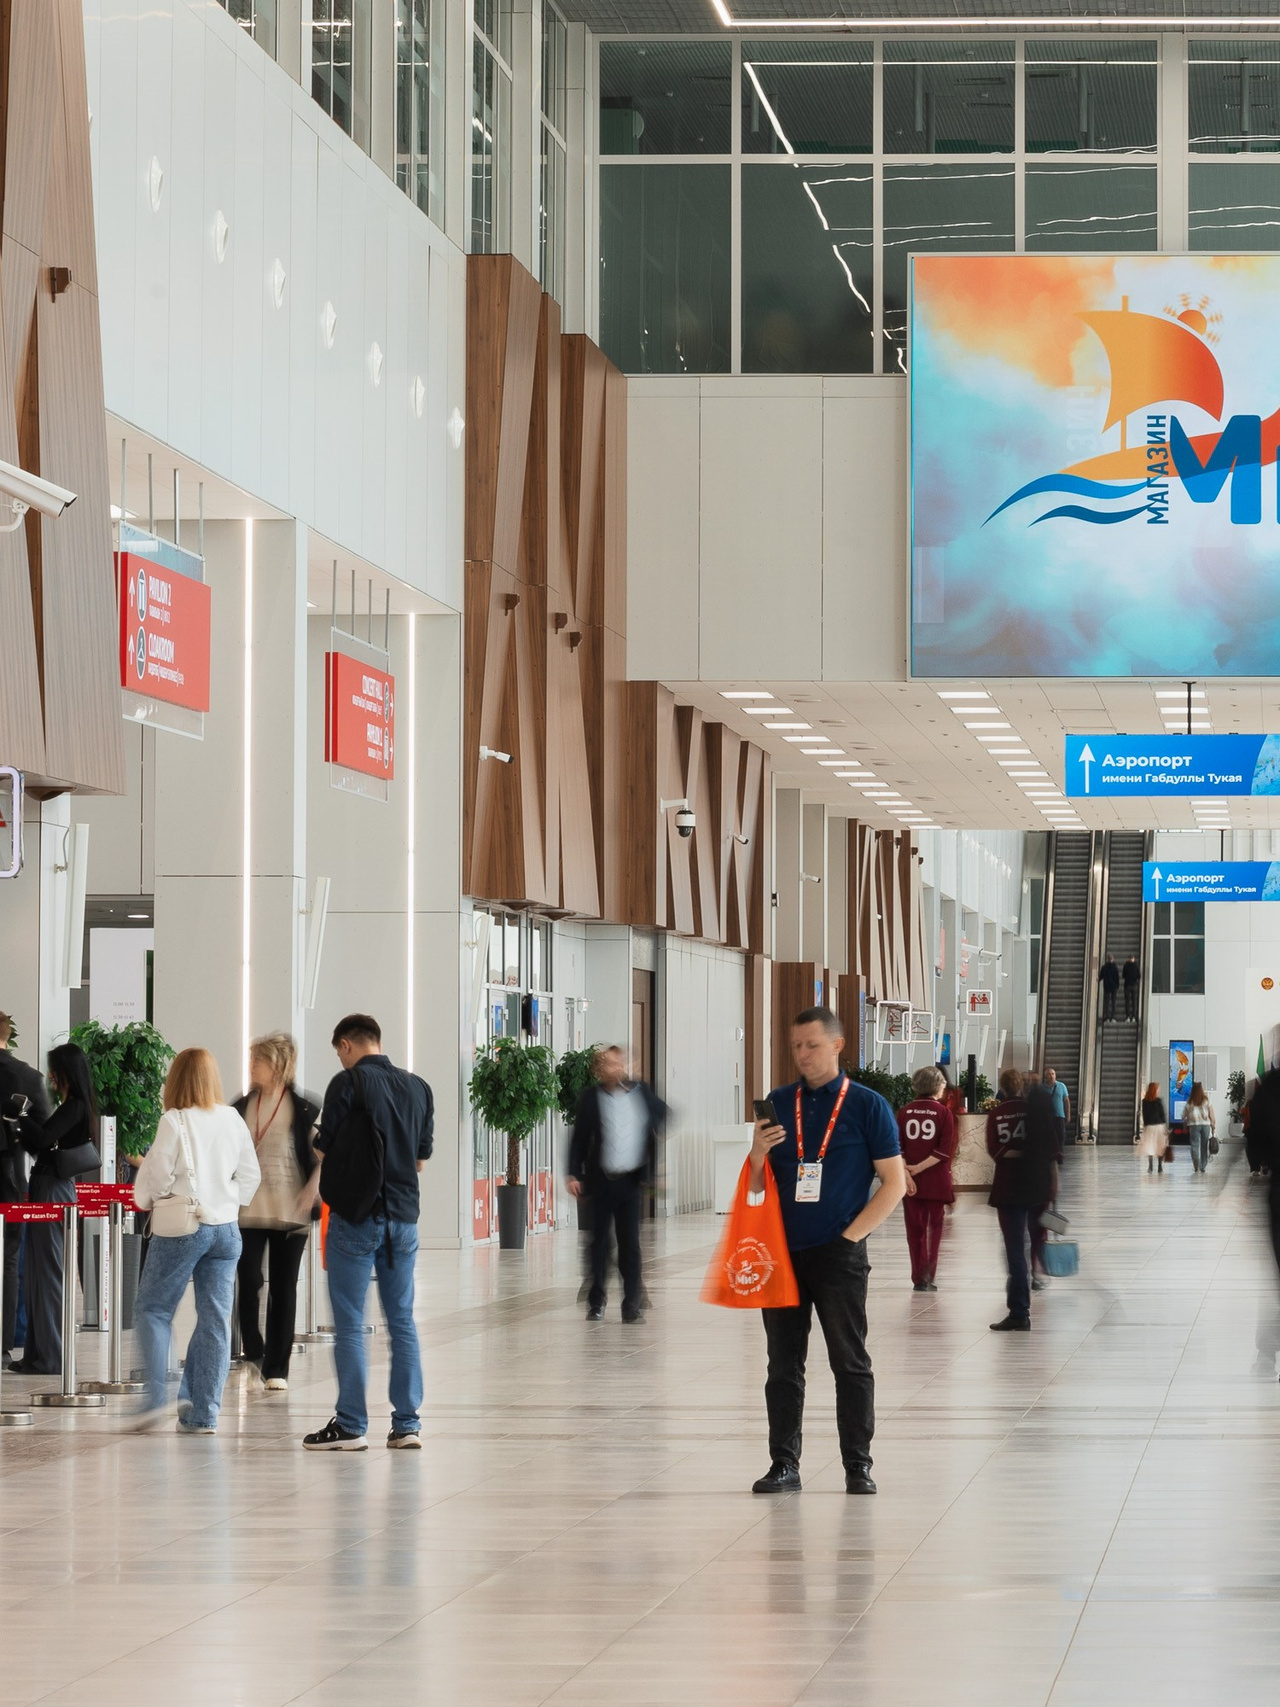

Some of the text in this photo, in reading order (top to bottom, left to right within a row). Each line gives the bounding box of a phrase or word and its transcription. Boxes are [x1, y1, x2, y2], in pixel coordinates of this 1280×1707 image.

[1147, 415, 1169, 524] МАГАЗИН
[1102, 754, 1192, 770] Аэропорт
[1102, 773, 1242, 785] имени Габдуллы Тукая
[1166, 874, 1225, 885] Аэропорт
[1194, 886, 1232, 894] Габдуллы
[906, 1119, 936, 1140] 09
[997, 1121, 1027, 1143] 54
